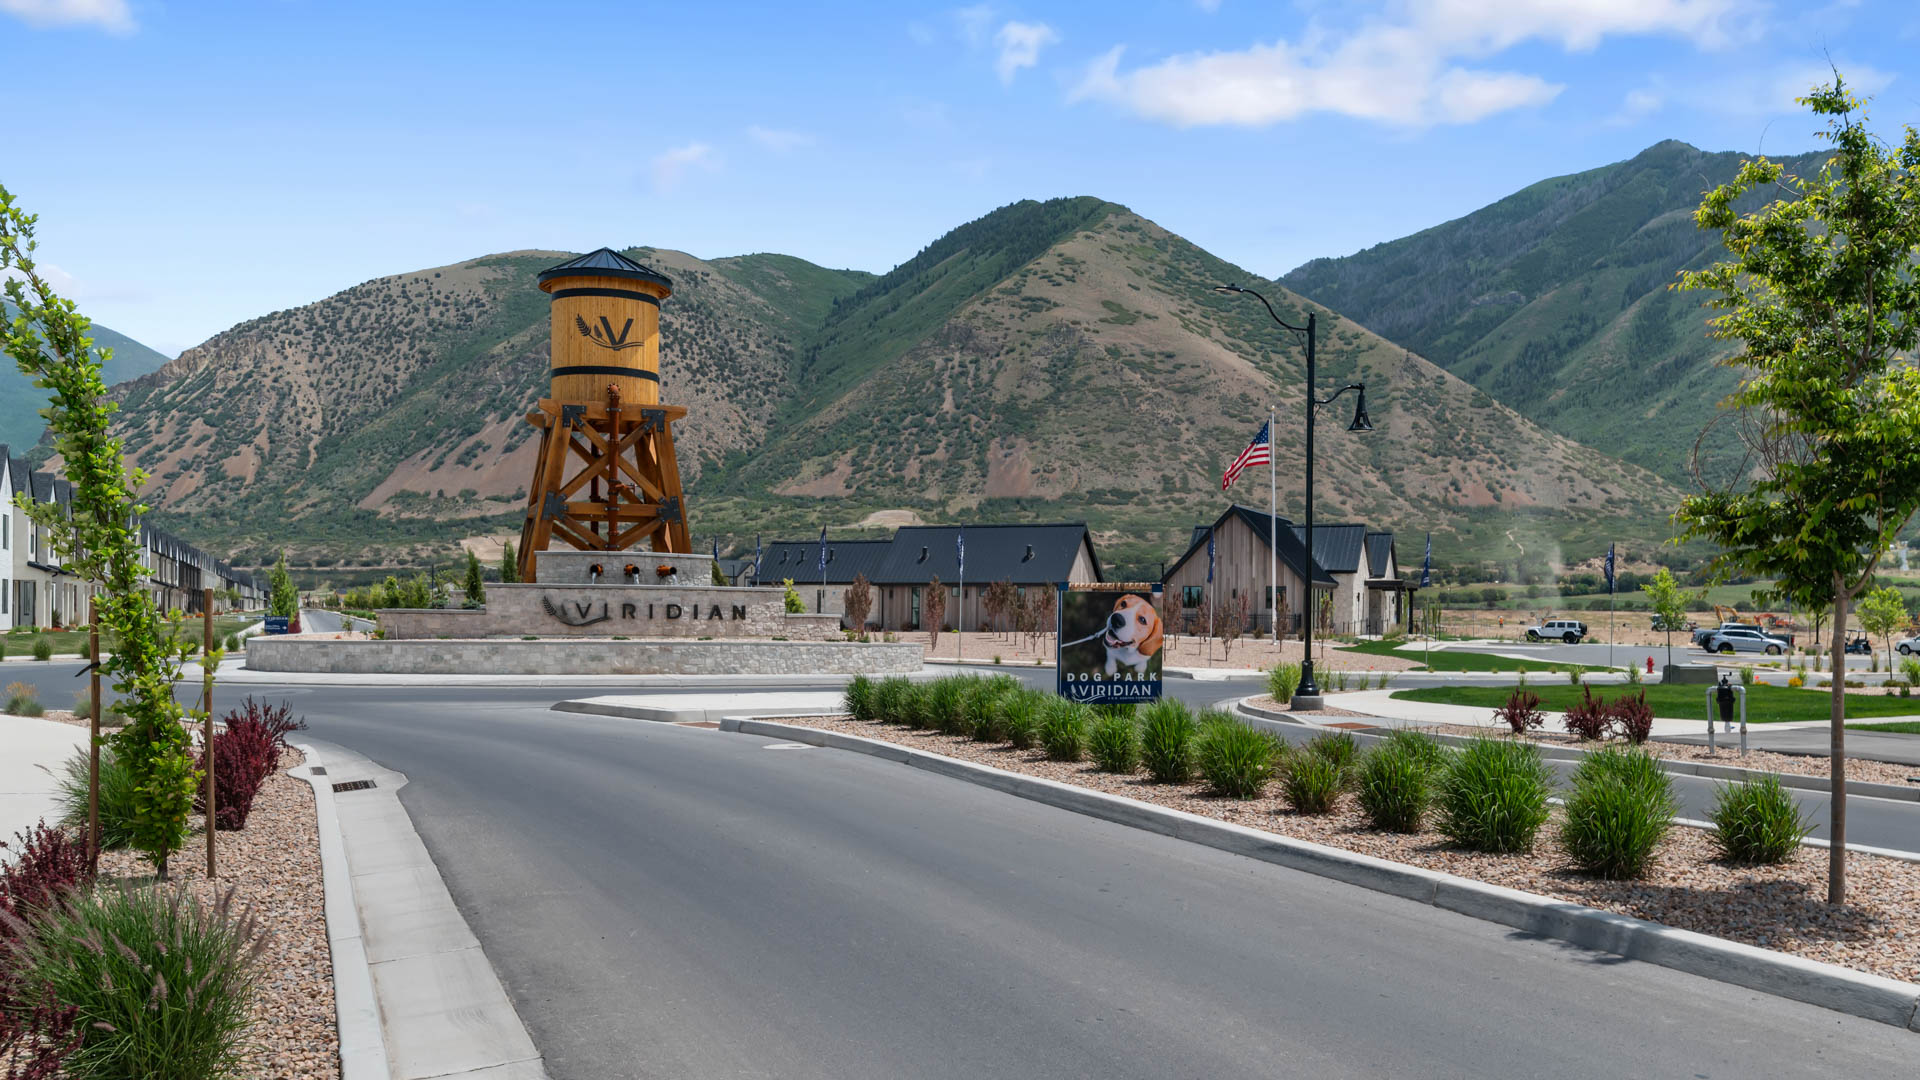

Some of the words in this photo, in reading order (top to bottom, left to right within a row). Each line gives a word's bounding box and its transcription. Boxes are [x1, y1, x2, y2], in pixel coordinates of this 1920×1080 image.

[600, 316, 634, 351] V
[576, 603, 746, 620] VIRIDIAN
[1067, 672, 1102, 682] DOG
[1113, 672, 1157, 682] PARK
[1079, 684, 1151, 696] VIRIDIAN
